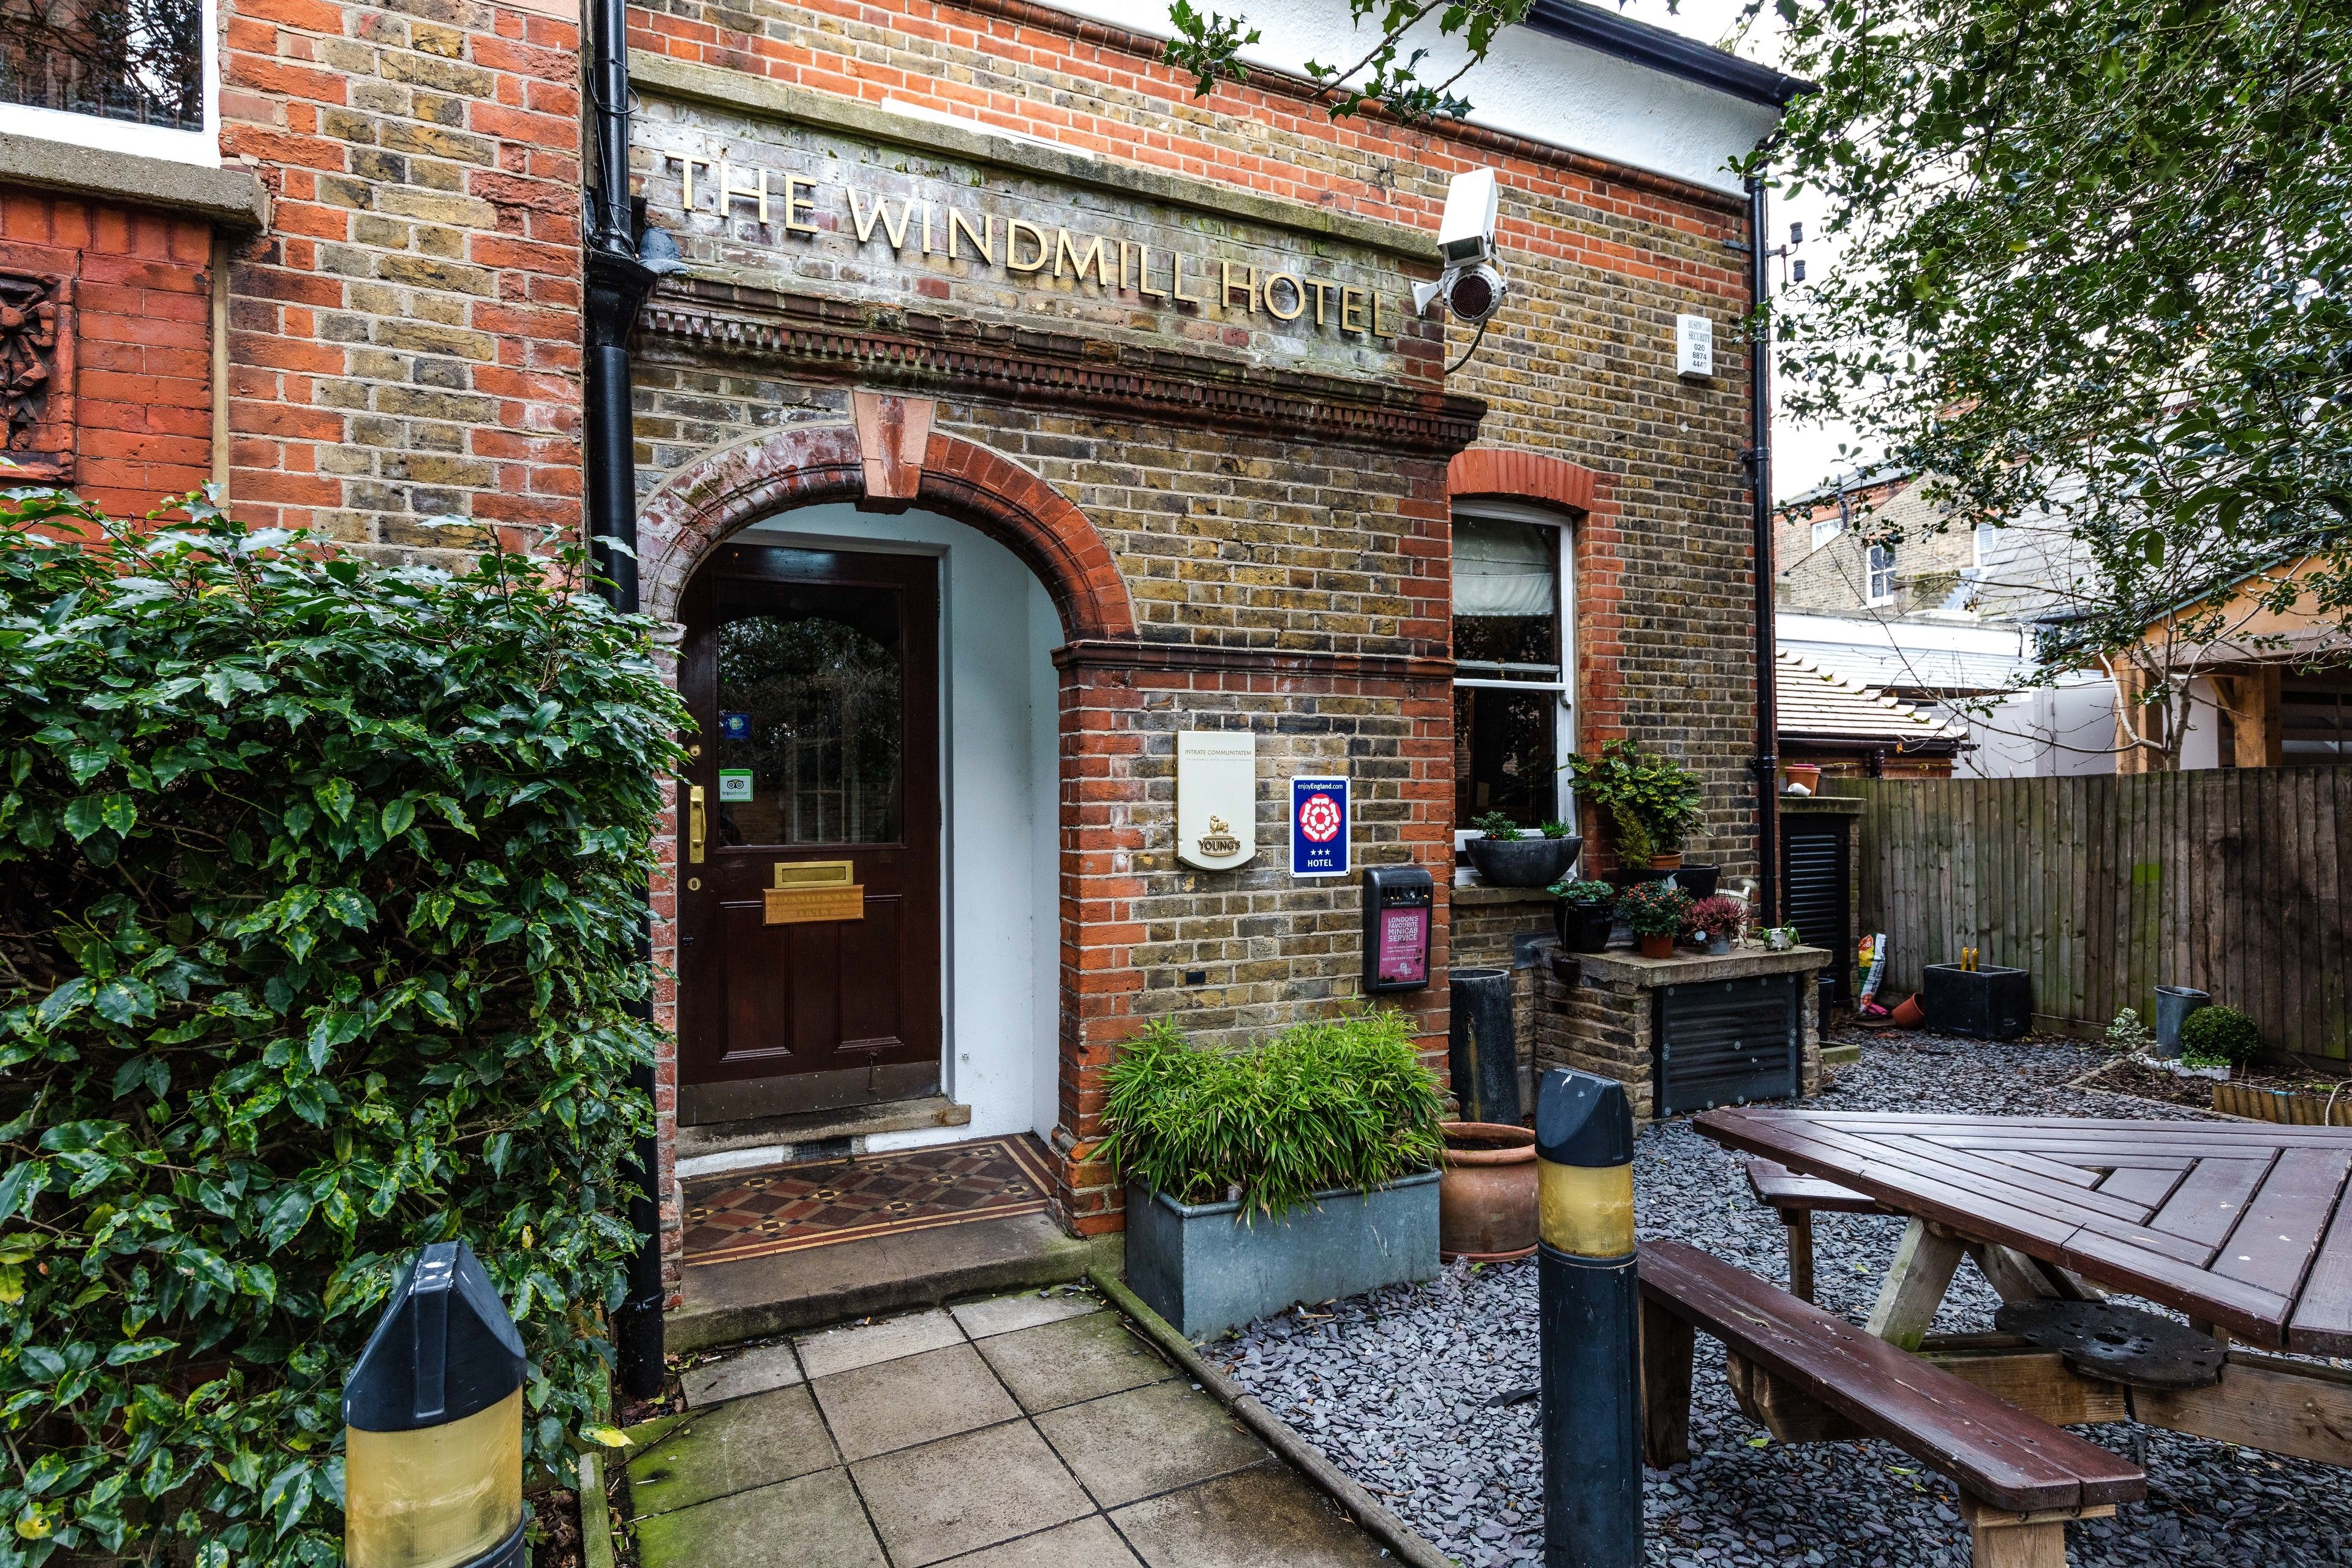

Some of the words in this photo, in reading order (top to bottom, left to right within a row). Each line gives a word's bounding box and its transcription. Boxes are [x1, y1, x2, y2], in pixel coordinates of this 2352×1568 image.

[664, 149, 820, 234] THE
[845, 186, 1200, 303] WINDMILL
[1222, 262, 1395, 338] HOTEL
[1688, 331, 1711, 343] SECURITY
[1692, 352, 1707, 360] 8874
[1197, 839, 1240, 851] YOUNG'S
[1388, 933, 1417, 942] SERVICE
